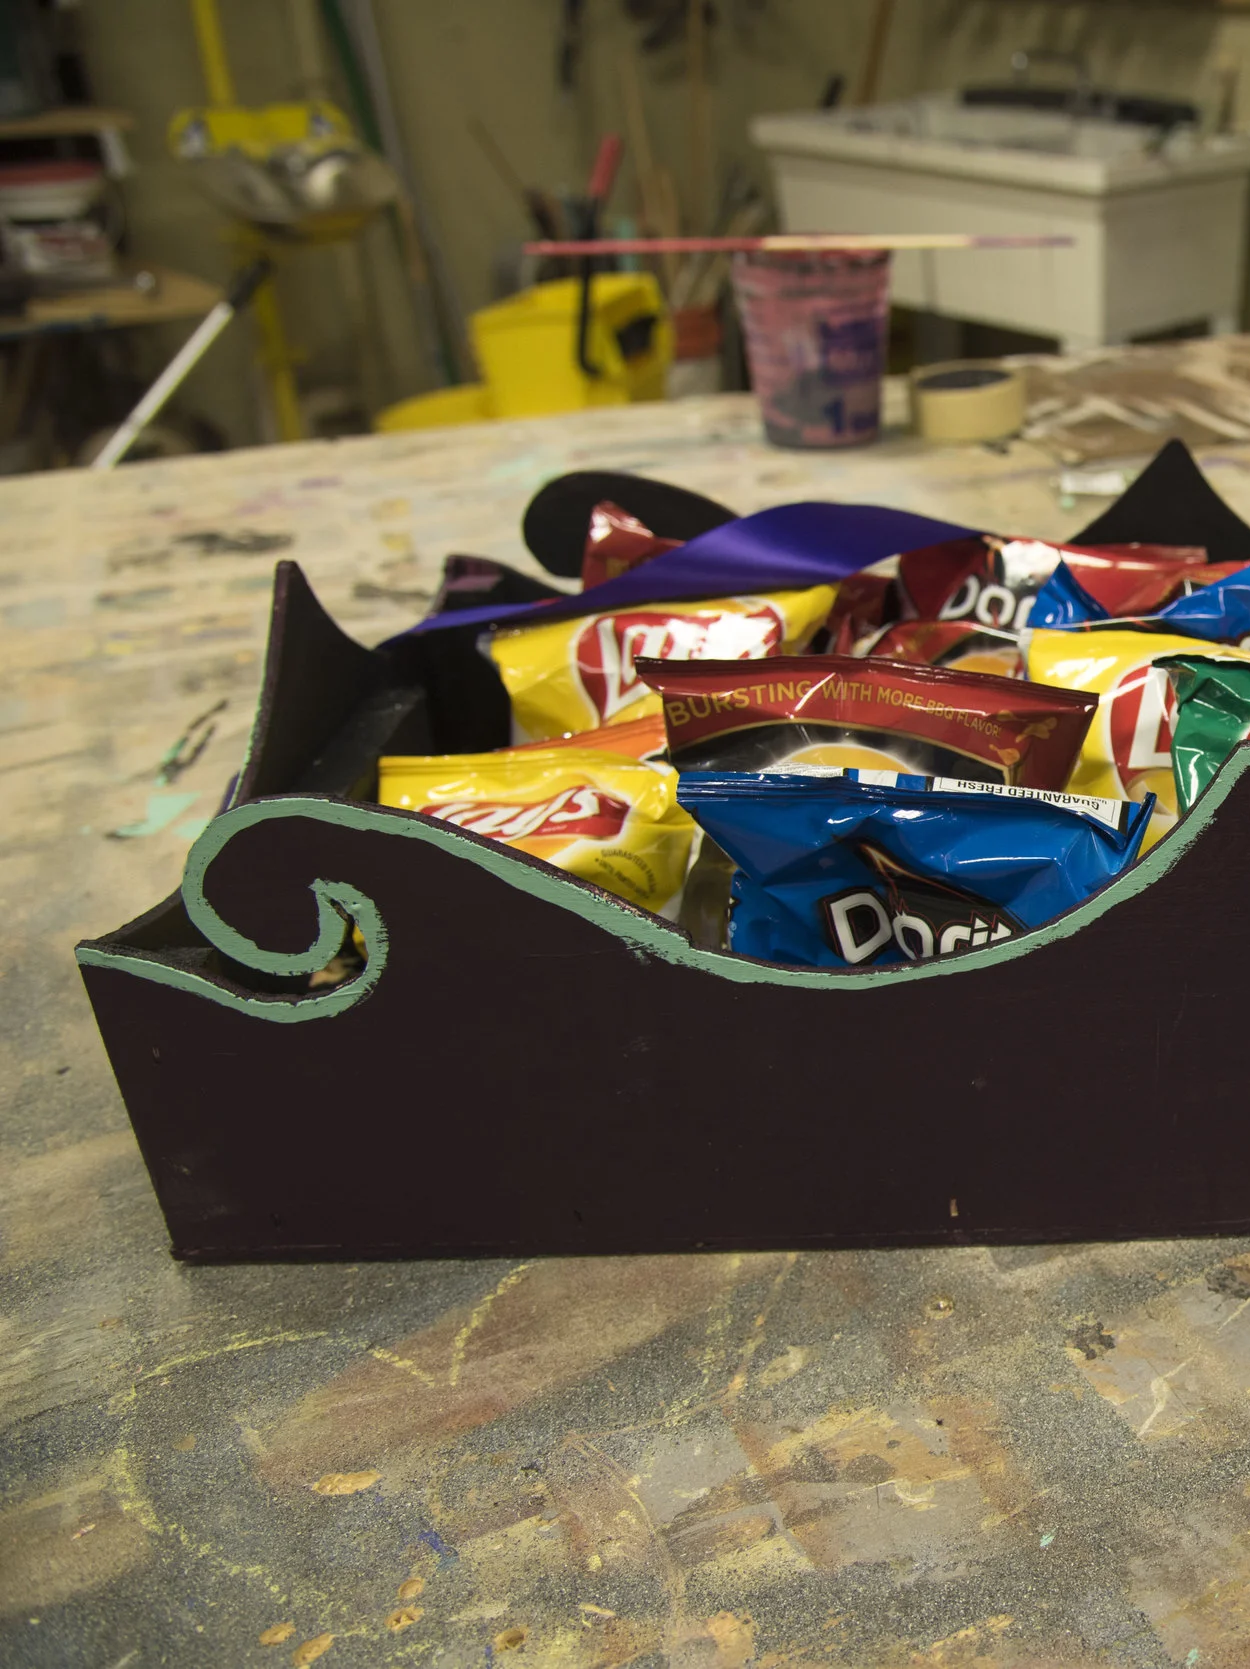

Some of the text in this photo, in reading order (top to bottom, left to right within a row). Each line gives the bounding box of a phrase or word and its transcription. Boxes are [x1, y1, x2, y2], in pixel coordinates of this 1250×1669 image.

[665, 680, 813, 728] BURSTING
[822, 679, 873, 703] WITH
[876, 686, 924, 712] MORE
[925, 700, 955, 721] BBQ
[957, 780, 1003, 795] FRESH
[1008, 787, 1100, 811] GUARANTEED
